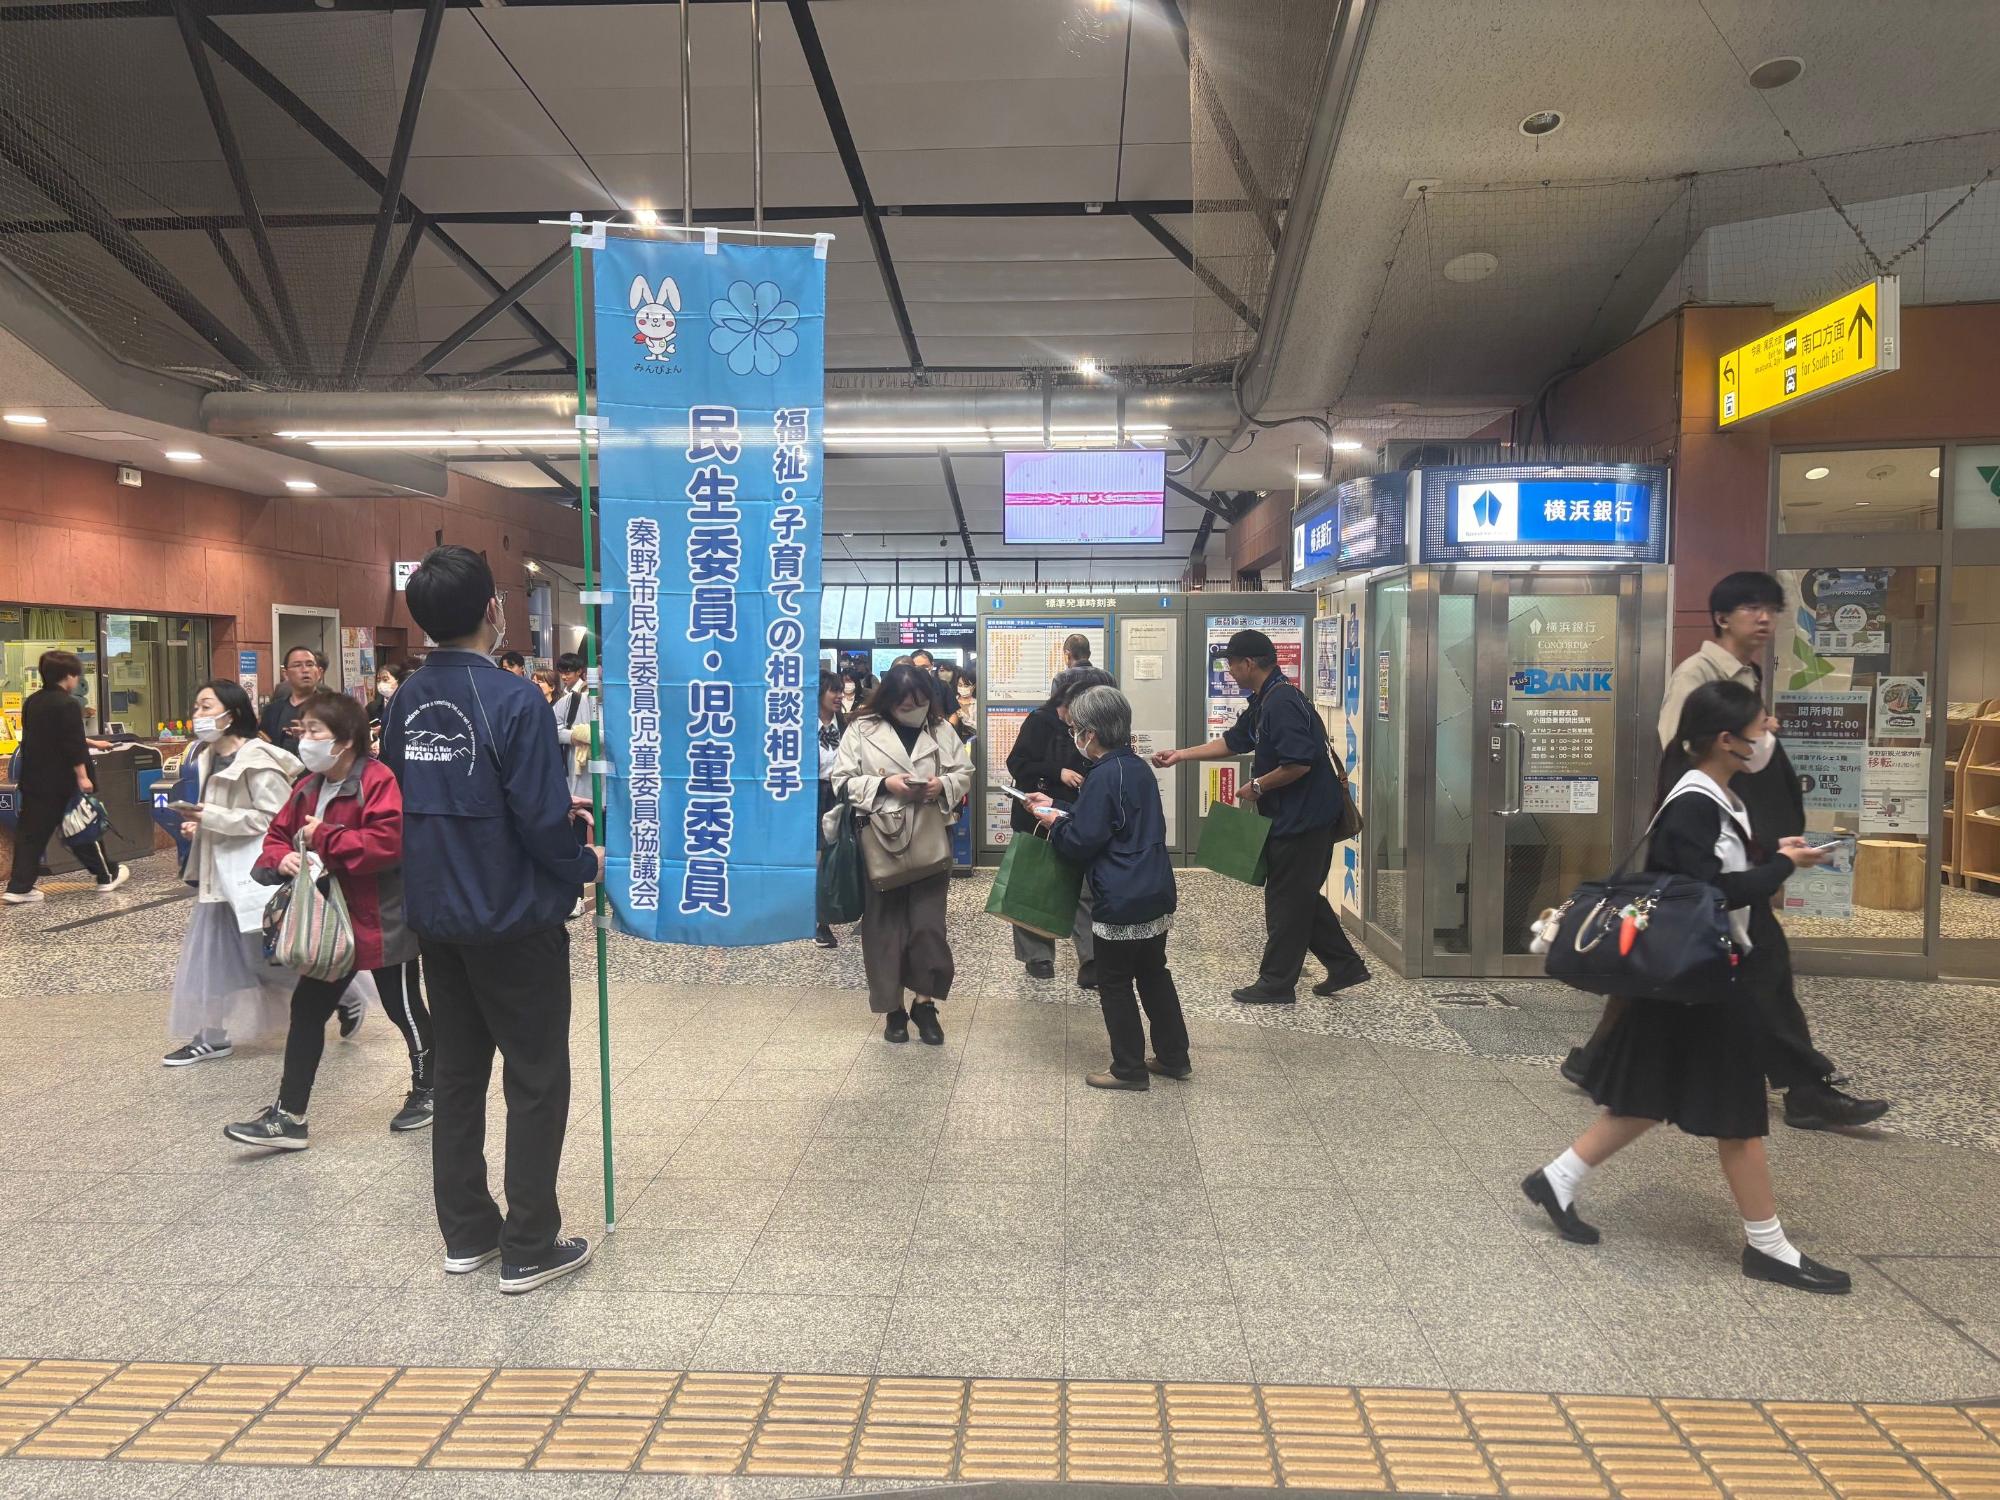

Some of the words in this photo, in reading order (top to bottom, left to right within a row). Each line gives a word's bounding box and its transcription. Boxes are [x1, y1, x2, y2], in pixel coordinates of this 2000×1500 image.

[1801, 317, 1845, 356] 南口方面
[1801, 361, 1811, 377] for
[1812, 352, 1830, 373] South
[1831, 346, 1845, 365] Exit
[1543, 499, 1633, 523] 横浜銀行
[1310, 520, 1333, 554] 横浜銀行
[764, 407, 810, 802] 福祉・子育ての相談相手
[1045, 598, 1117, 608] 標準発車時刻表
[1545, 621, 1597, 633] 横浜銀行
[1537, 640, 1589, 649] CONCORDIA
[680, 404, 742, 917] 民生委員・児童委員
[1524, 668, 1613, 695] BANK
[627, 516, 662, 911] 秦野市民生委員児童委員協議会
[1798, 706, 1844, 717] 開所時間
[1782, 720, 1808, 728] 8:30
[1825, 720, 1859, 729] 17:00
[404, 751, 453, 762] HADANO
[62, 797, 98, 838] NIKE
[265, 1122, 284, 1136] N
